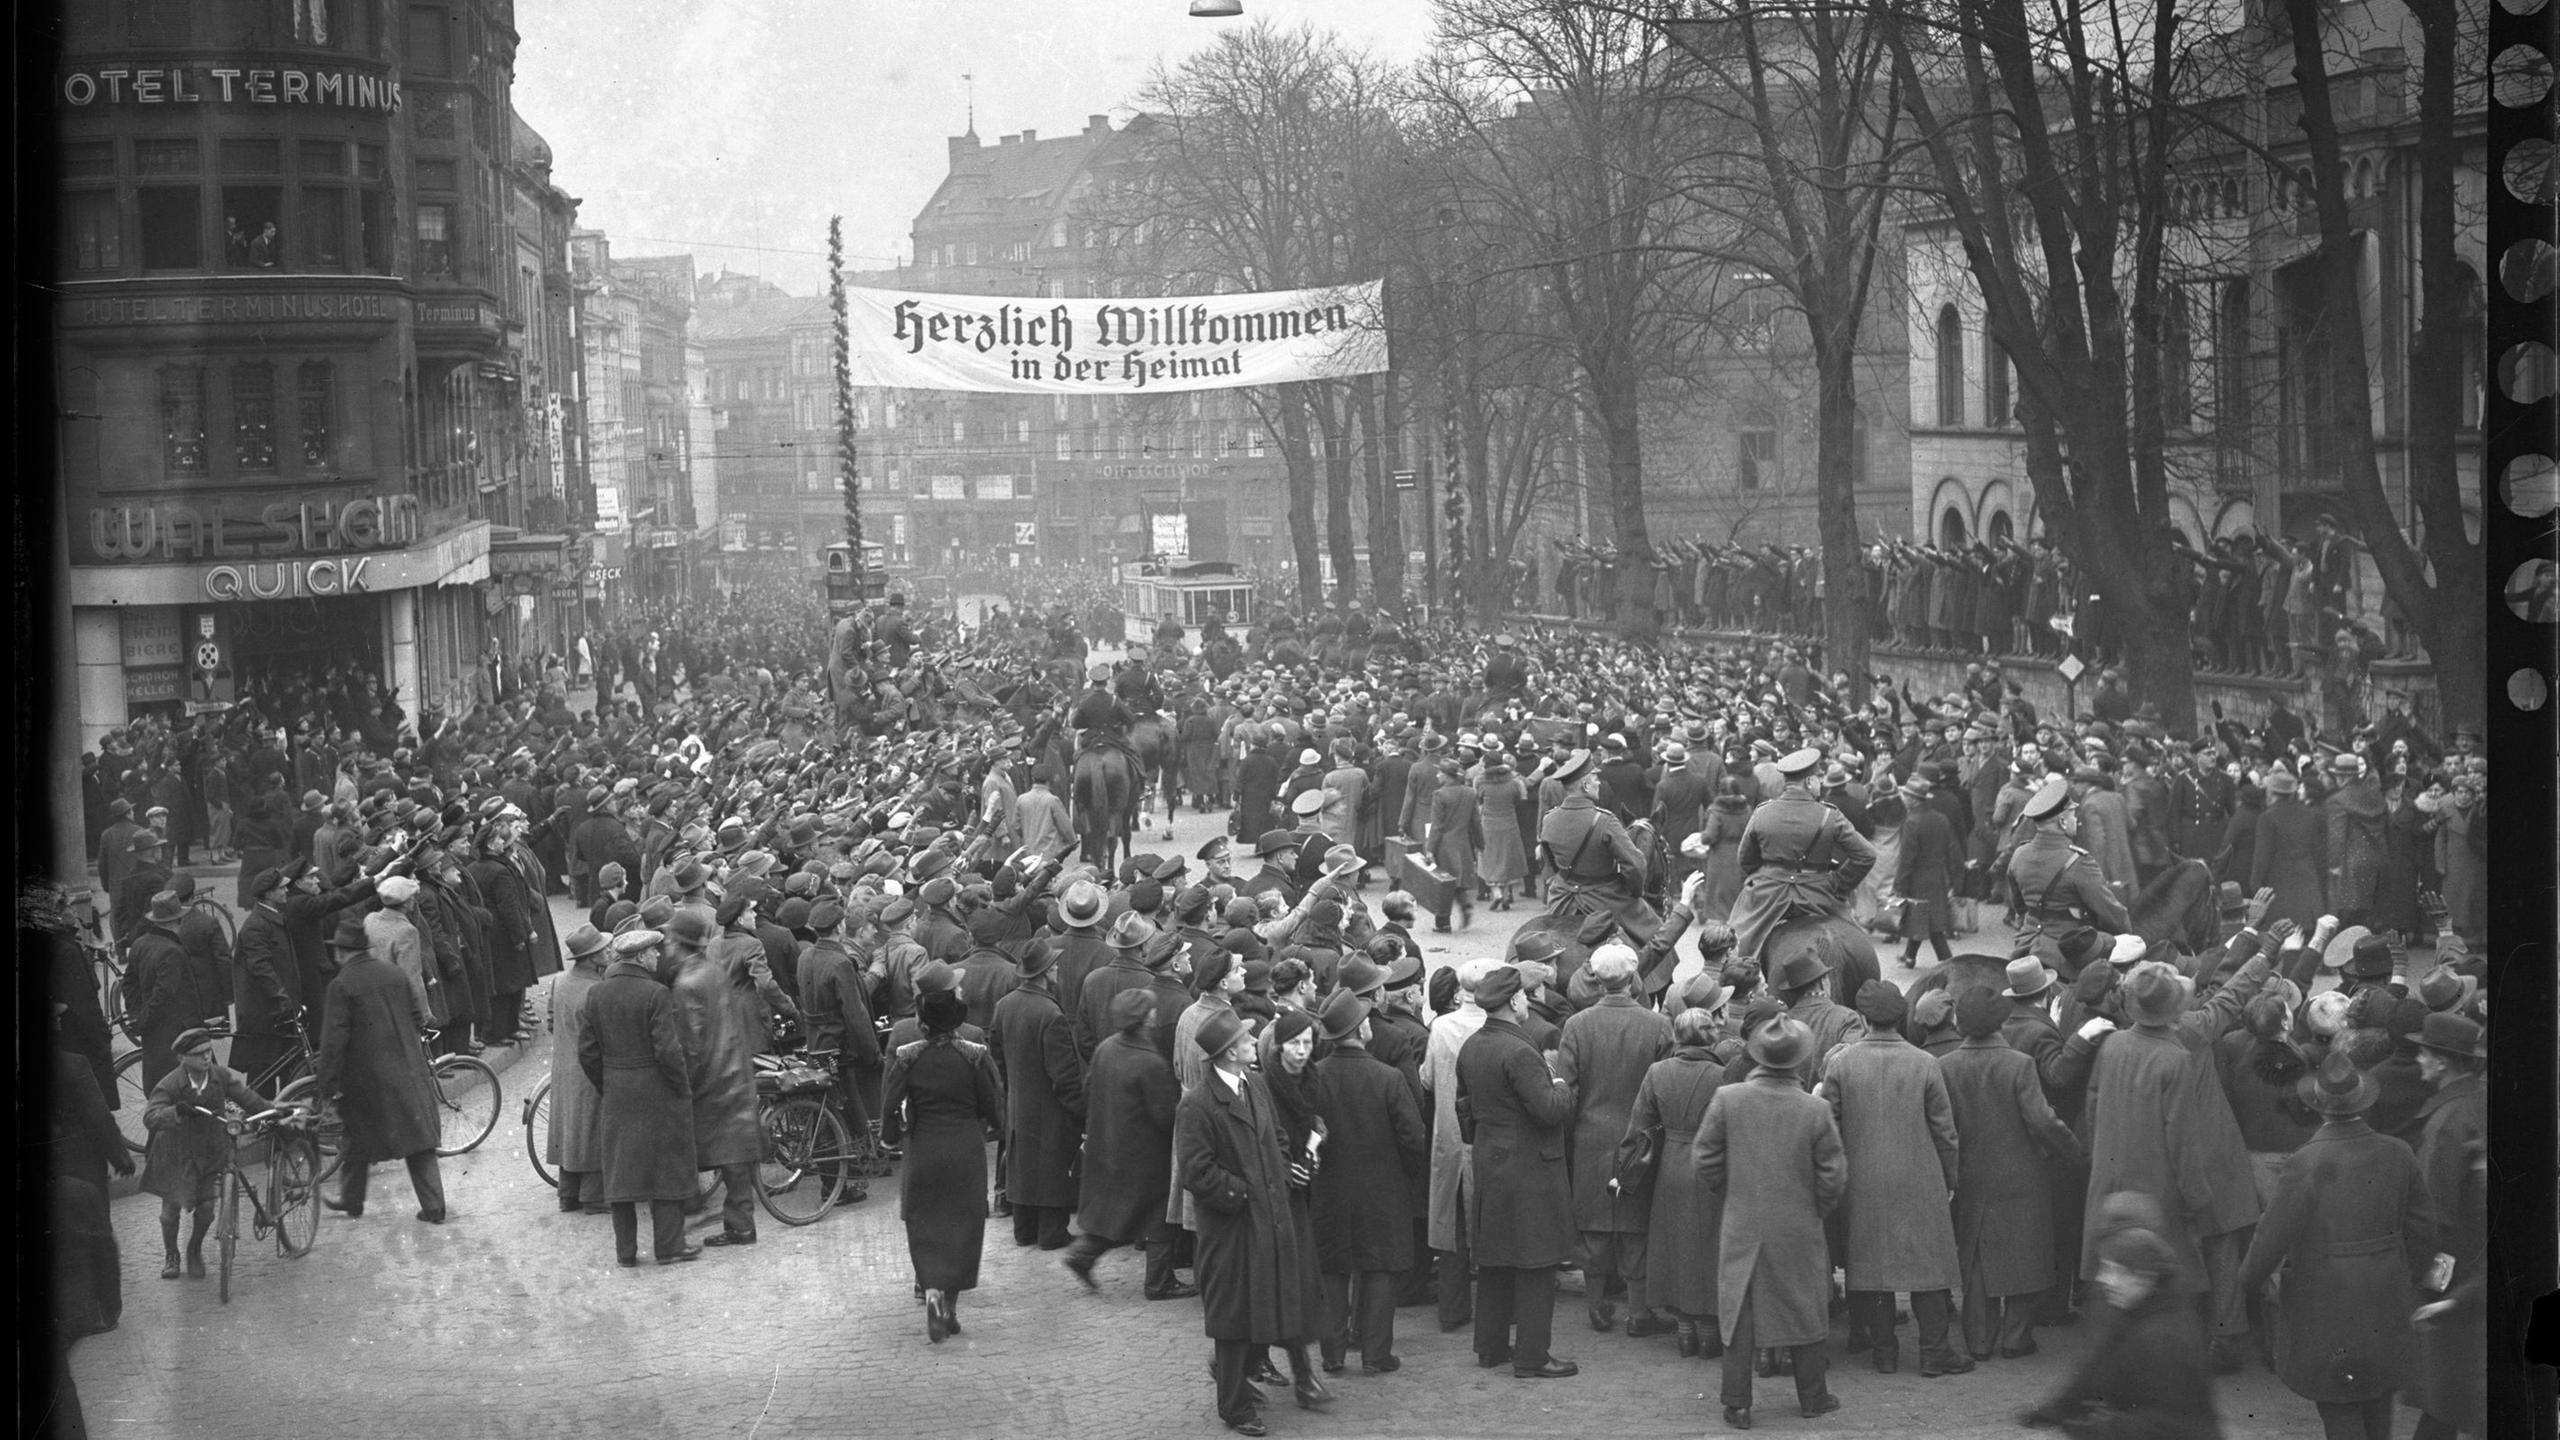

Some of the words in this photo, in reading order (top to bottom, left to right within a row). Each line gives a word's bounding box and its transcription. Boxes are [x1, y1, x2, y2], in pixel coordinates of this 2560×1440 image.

[54, 69, 198, 105] OTEL
[212, 69, 401, 113] TERMINUS
[338, 296, 387, 318] HOTEL
[417, 302, 475, 321] Terminus
[893, 300, 1072, 354] Herzlich
[1096, 304, 1347, 347] Willkommen
[1011, 350, 1042, 381] in
[1054, 351, 1110, 381] der
[1122, 350, 1243, 388] Heimat
[91, 495, 418, 558] WALSHEIM
[206, 557, 370, 600] QUICK
[128, 685, 175, 698] KELLER
